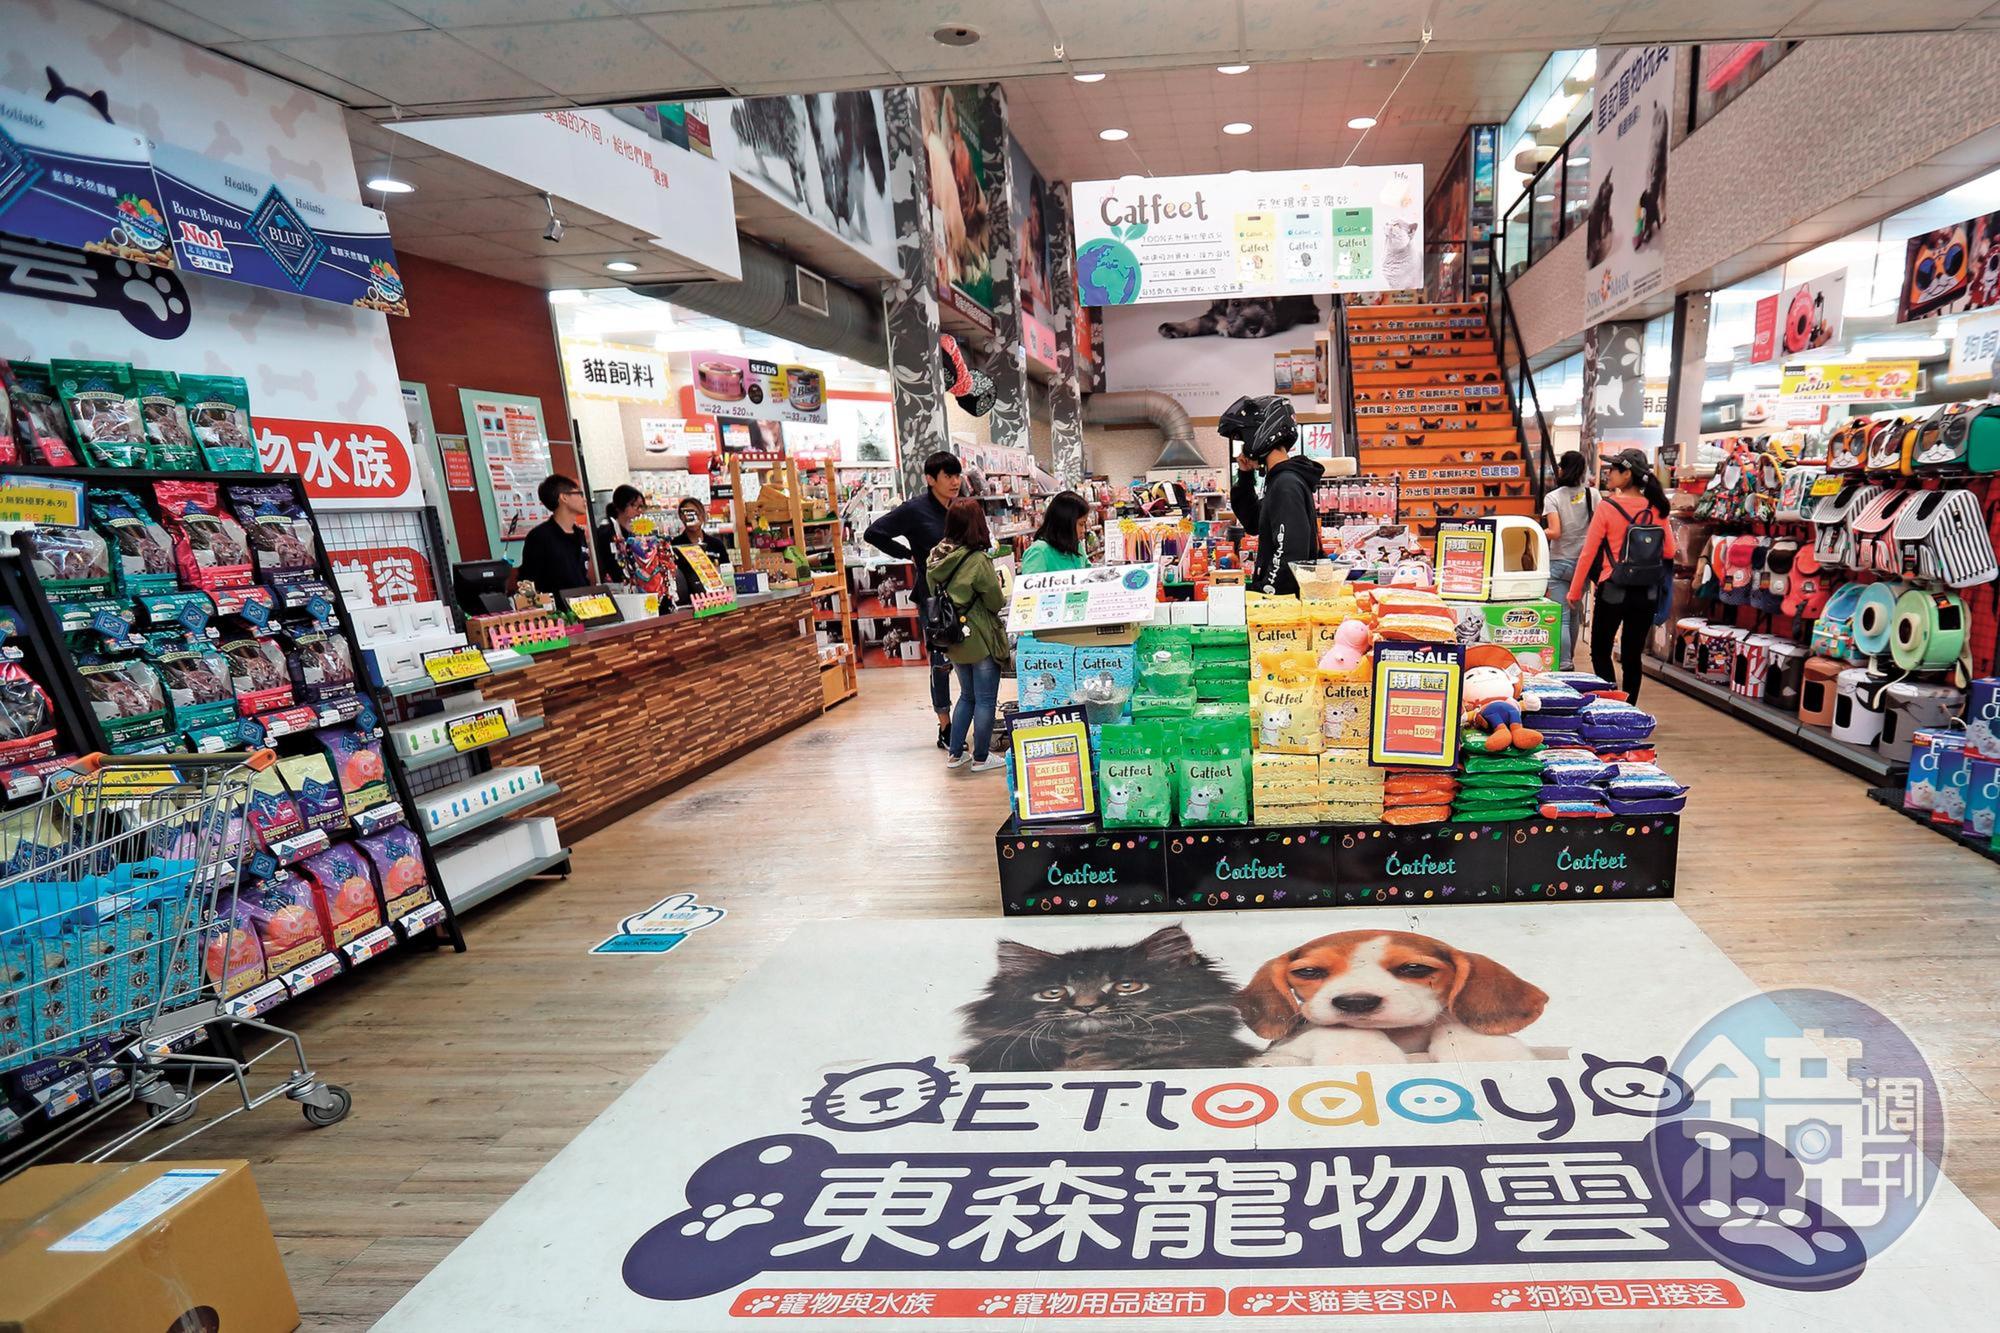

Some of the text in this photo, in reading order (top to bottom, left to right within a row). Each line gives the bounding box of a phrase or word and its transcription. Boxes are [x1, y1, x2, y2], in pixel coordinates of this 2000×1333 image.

[1394, 171, 1408, 180] Tofu
[224, 176, 259, 196] Healthy
[295, 198, 327, 216] Holistic
[1101, 191, 1208, 226] Catfeet
[180, 221, 224, 249] No.1
[268, 227, 305, 249] BLUE
[583, 358, 654, 389] 貓飼料
[750, 363, 777, 376] SEEDS
[1398, 389, 1415, 398] 全館
[1308, 426, 1332, 450] 物
[1408, 469, 1428, 479] 全館
[1481, 465, 1519, 477] 包退包換
[1405, 487, 1430, 496] 外出包
[1462, 524, 1492, 532] SALE
[1024, 575, 1077, 590] Catfeet
[1258, 630, 1298, 641] Catfeet
[1082, 658, 1123, 671] Catfeet
[1414, 651, 1458, 664] SALE
[1023, 660, 1064, 671] Catfeet
[1392, 673, 1421, 690] 特價
[1264, 691, 1303, 705] Catfeet
[1325, 686, 1369, 698] Catfeet
[1041, 711, 1082, 726] SALE
[1352, 729, 1361, 737] 7L
[1108, 765, 1153, 778] Catfeet
[1190, 765, 1233, 779] Catfeet
[1220, 810, 1229, 818] 7L
[1385, 854, 1456, 876] Catfeet
[1556, 849, 1627, 871] Catfeet
[1047, 863, 1117, 886] Catfeet
[1215, 858, 1286, 880] Catfeet
[952, 1071, 1563, 1141] ETtoday
[769, 1152, 1671, 1263] 東森寵物雲
[776, 1290, 1206, 1315] 寵物與水族 寵物用品超市
[1276, 1282, 1729, 1313] 犬貓美容SPA 狗狗包月接送
